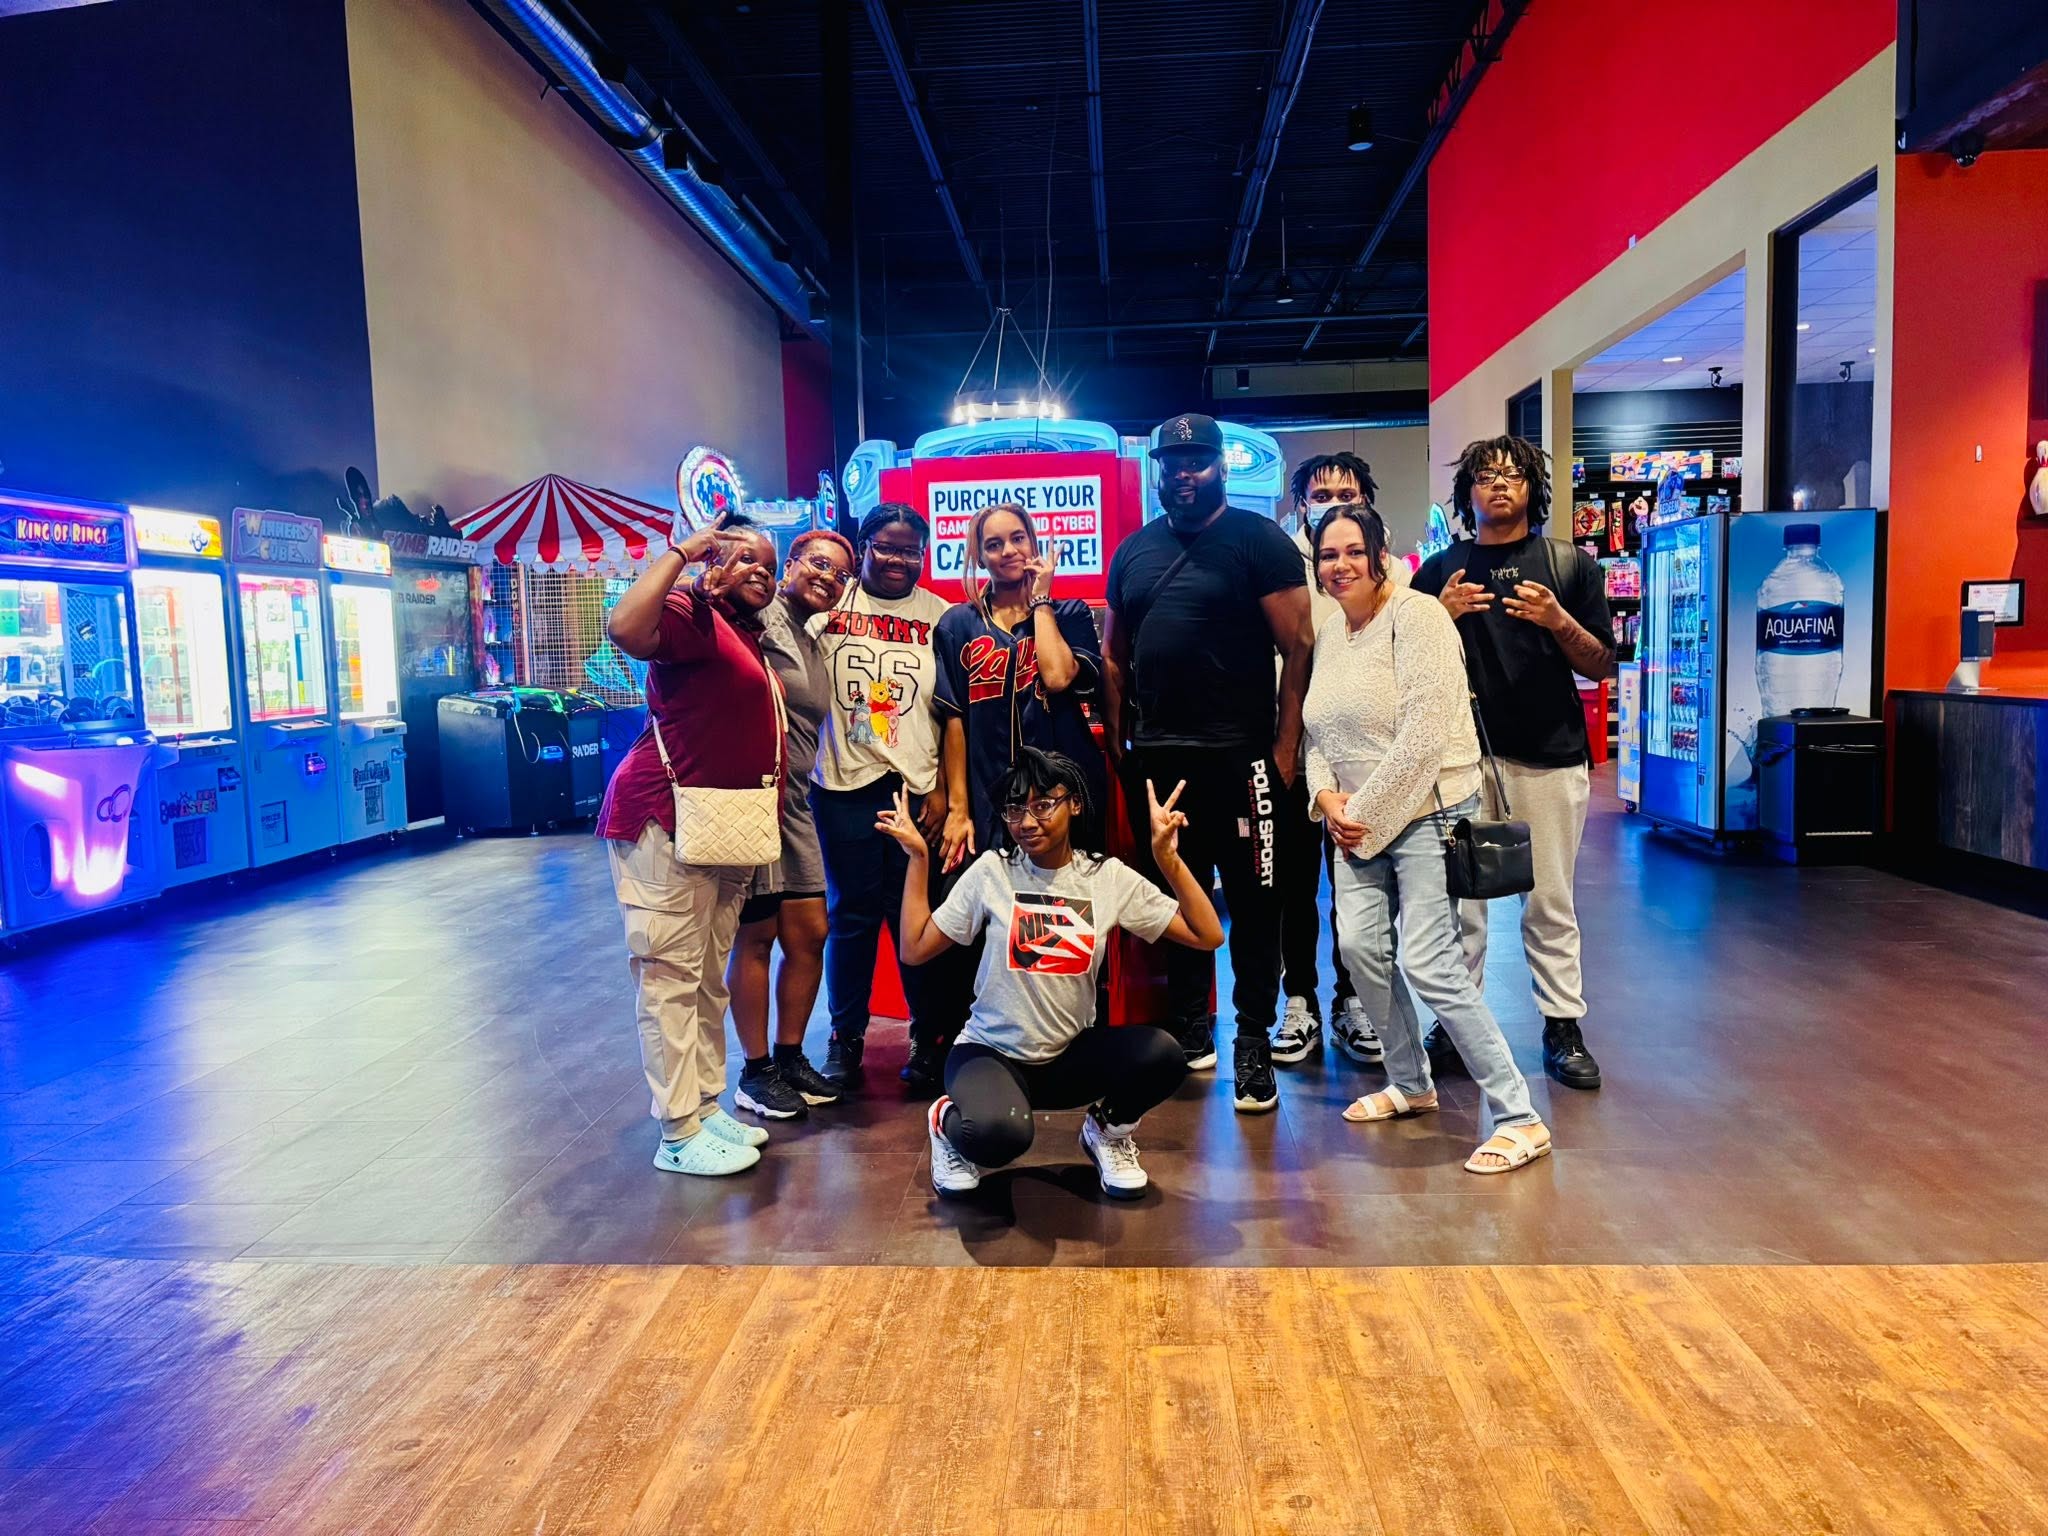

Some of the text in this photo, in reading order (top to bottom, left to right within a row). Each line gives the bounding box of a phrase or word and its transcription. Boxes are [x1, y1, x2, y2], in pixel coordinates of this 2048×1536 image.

[934, 485, 1094, 512] PURCHASE YOUR
[17, 517, 50, 542] KING
[53, 521, 69, 543] OF
[72, 521, 108, 545] RINGS
[1052, 514, 1094, 532] CYBER
[383, 530, 428, 557] TOMB
[426, 535, 478, 560] RAIDER
[406, 593, 436, 605] RAIDER
[1765, 615, 1837, 640] AQUAFINA
[834, 643, 920, 716] 66
[572, 743, 600, 759] RAIDER
[1250, 759, 1274, 888] POLO SPORT
